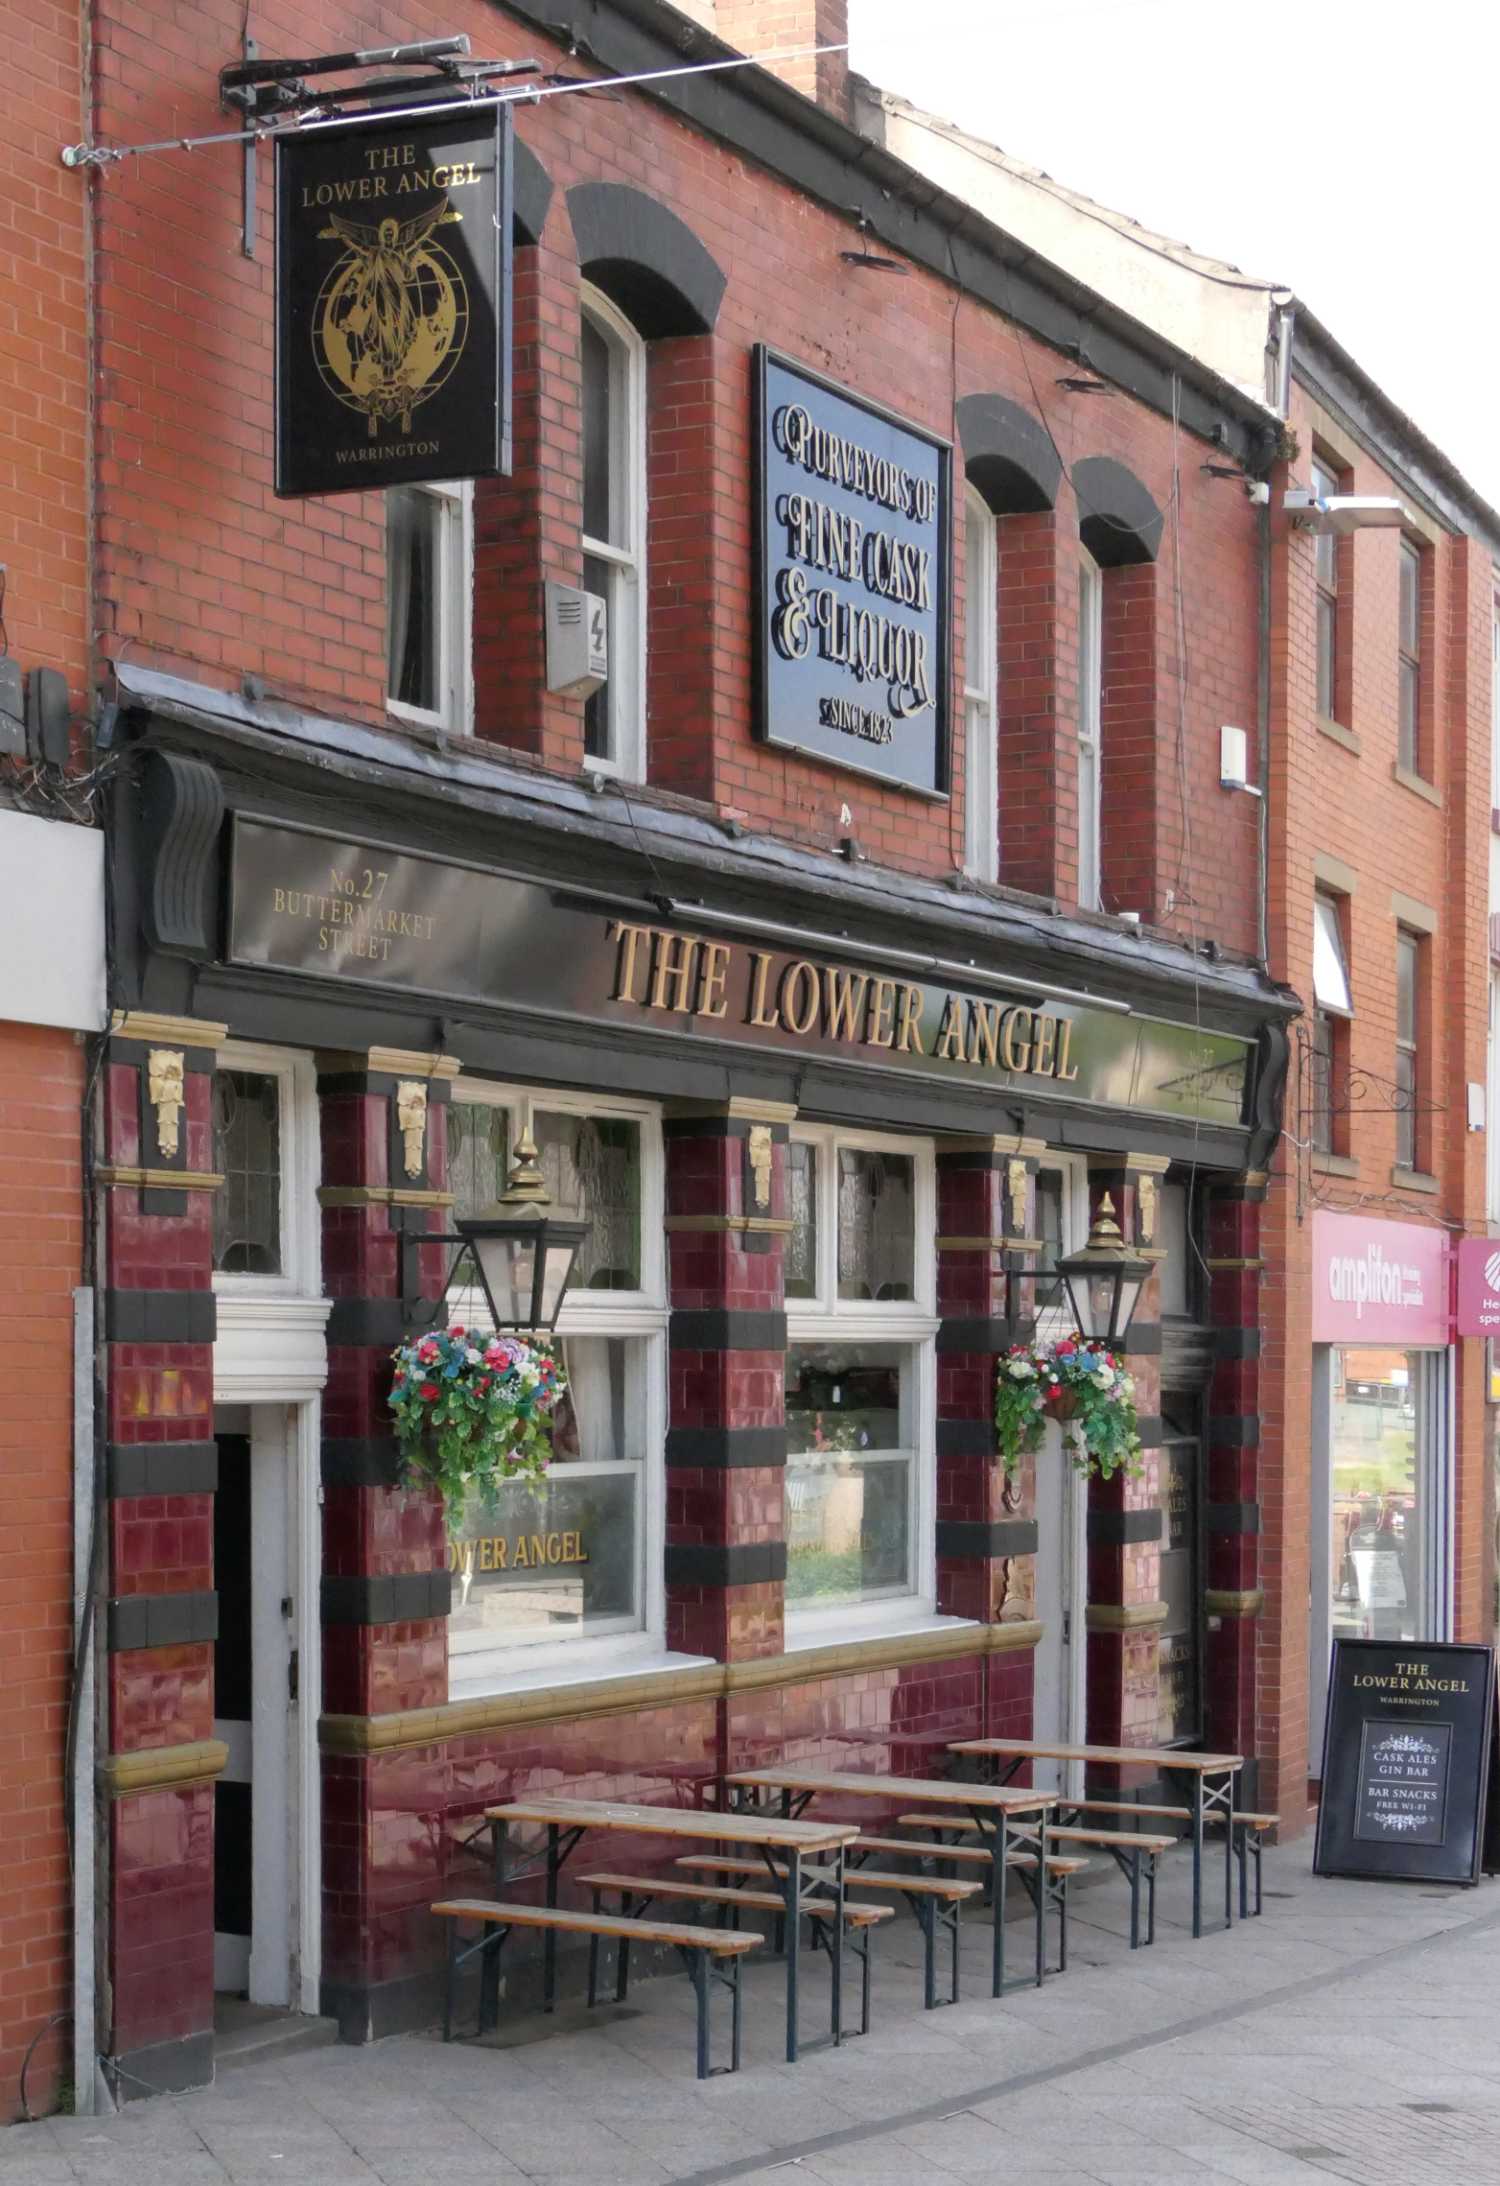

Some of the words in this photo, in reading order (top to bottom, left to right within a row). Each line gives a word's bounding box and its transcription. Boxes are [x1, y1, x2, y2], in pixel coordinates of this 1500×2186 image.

[365, 145, 416, 170] THE
[302, 176, 389, 208] LOWER
[397, 163, 481, 194] ANGEL
[336, 441, 441, 464] WARRINGTON
[784, 404, 911, 512] PURVEYORS
[915, 480, 936, 523] OF
[788, 493, 863, 581] FINE
[874, 531, 933, 611] CASK
[784, 567, 811, 660] &
[816, 588, 937, 718] LIQUOR
[830, 697, 868, 735] SINCE
[869, 711, 894, 744] 1823
[273, 888, 438, 940] BUTTERMARKET
[319, 928, 392, 961] STREET
[612, 920, 731, 1019] THE
[750, 952, 925, 1055] LOWER
[936, 994, 1079, 1081] ANGEL
[447, 1536, 507, 1573] OWER
[512, 1531, 588, 1568] ANGEL
[1395, 1662, 1429, 1676] THE
[1353, 1675, 1410, 1690] LOWER
[1415, 1679, 1470, 1693] ANGEL
[1379, 1696, 1440, 1707] WARRINGTON
[1373, 1752, 1405, 1763] CASK
[1408, 1754, 1438, 1765] ALES
[1379, 1765, 1402, 1776] GIN
[1407, 1766, 1430, 1777] BAR
[1368, 1787, 1390, 1798] BAR
[1392, 1788, 1438, 1801] SNACKS
[1376, 1801, 1398, 1810] FREE
